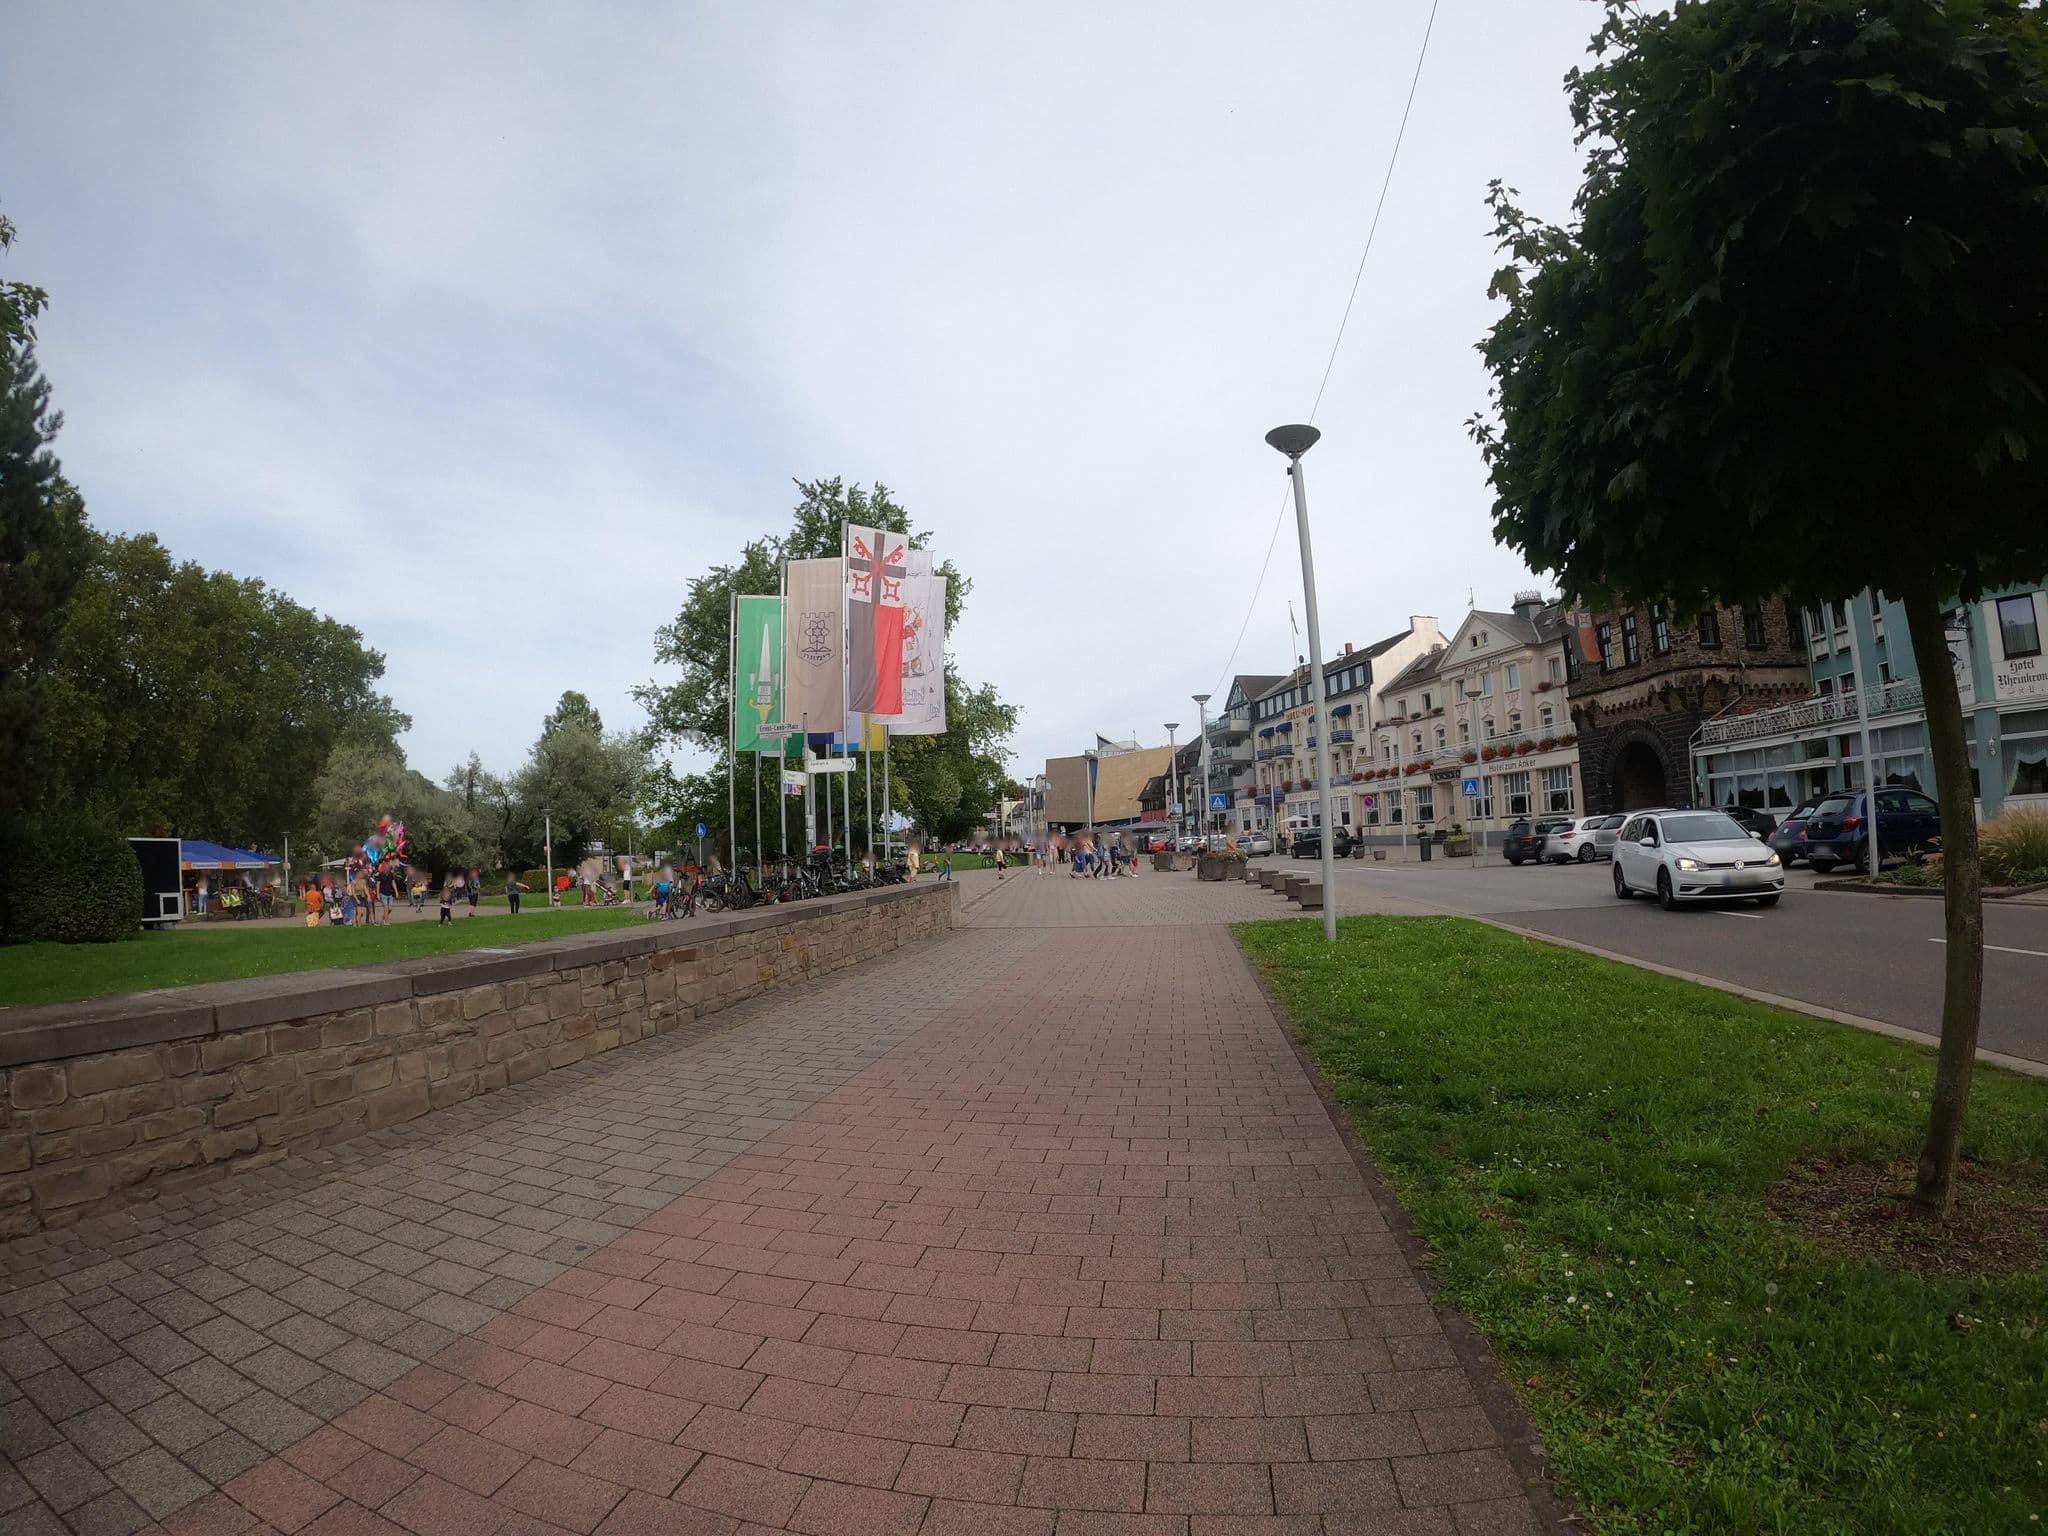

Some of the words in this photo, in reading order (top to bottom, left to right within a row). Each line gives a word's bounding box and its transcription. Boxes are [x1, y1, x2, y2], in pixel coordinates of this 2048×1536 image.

[2009, 659, 2035, 674] Hotel
[1997, 672, 2048, 689] Rheinkron
[1488, 763, 1504, 772] Hotel
[1518, 759, 1536, 767] Anker
